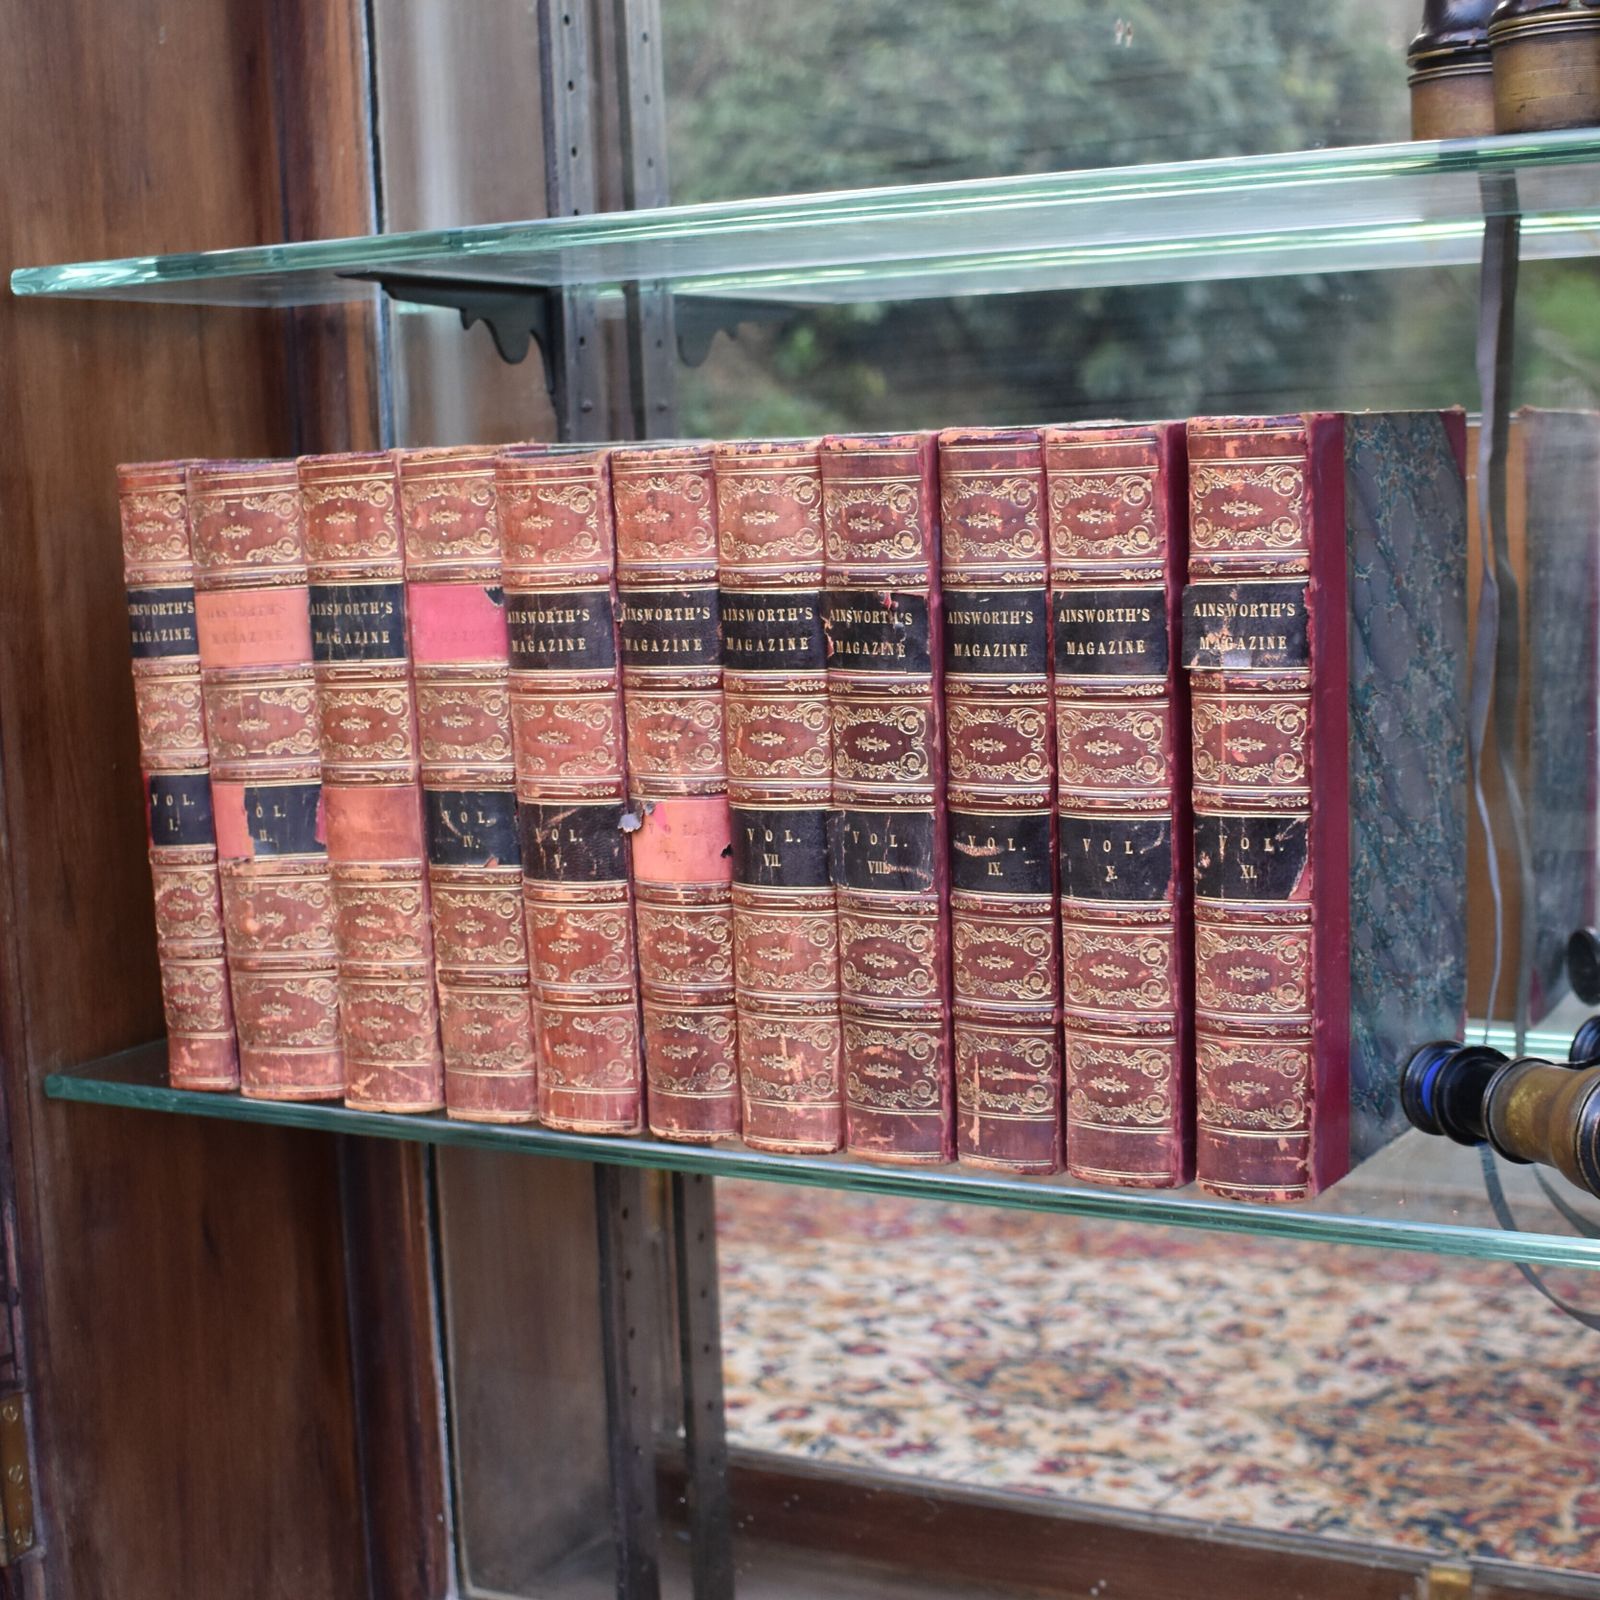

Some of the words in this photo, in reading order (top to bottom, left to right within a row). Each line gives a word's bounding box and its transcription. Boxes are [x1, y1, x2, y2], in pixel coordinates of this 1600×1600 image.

[310, 602, 394, 616] AINSWORTH'S
[507, 608, 590, 624] AINSWORTH'S
[622, 607, 711, 622] AINSWORTH'S
[722, 607, 814, 622] AINSWORTH'S
[1059, 608, 1151, 623] AINSWORTH'S
[1193, 602, 1296, 618] AINSWORTH'S
[947, 610, 1034, 625] AINSWORTH'S
[132, 627, 192, 644] MAGAZINE
[315, 630, 391, 645] MAGAZINE
[1199, 635, 1288, 651] MAGAZINE
[511, 637, 587, 653] MAGAZINE
[624, 638, 703, 653] MAGAZINE
[726, 637, 809, 652] MAGAZINE
[835, 640, 906, 658] MAGAZINE
[953, 643, 1029, 658] MAGAZINE
[1066, 640, 1147, 656] MAGAZINE
[152, 793, 196, 807] VOL.
[256, 804, 288, 818] OL.
[441, 809, 492, 825] VOL.
[747, 828, 801, 843] VOL.
[852, 831, 909, 848] VOL.
[968, 835, 1027, 851] VOL.
[1218, 834, 1285, 852] VOL.
